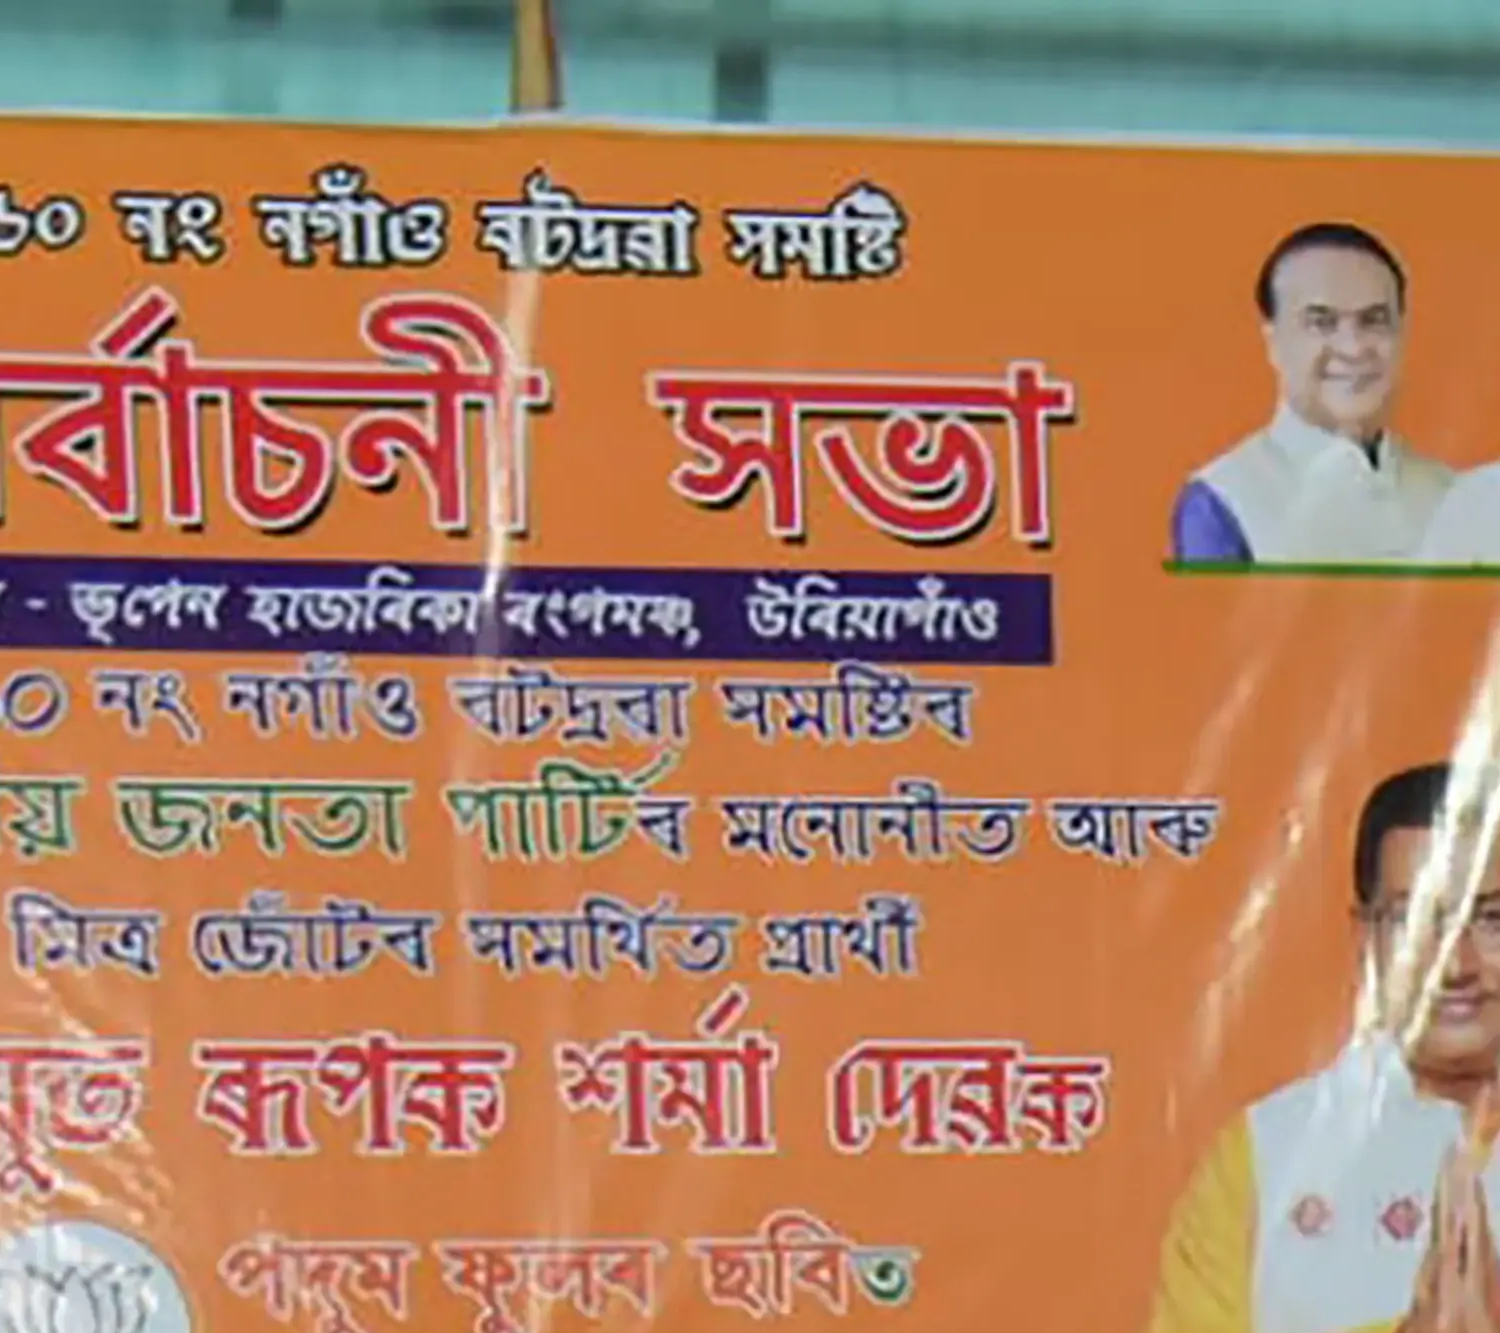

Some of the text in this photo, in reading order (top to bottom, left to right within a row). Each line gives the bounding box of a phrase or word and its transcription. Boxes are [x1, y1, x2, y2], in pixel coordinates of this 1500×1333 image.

[117, 190, 222, 262] নং
[257, 166, 446, 266] নগাঁও
[645, 358, 1076, 547] সভা
[92, 668, 202, 740] নং
[227, 654, 422, 737] নগাঁও
[113, 779, 414, 857] জনতা
[720, 780, 1030, 860] মনোনীত
